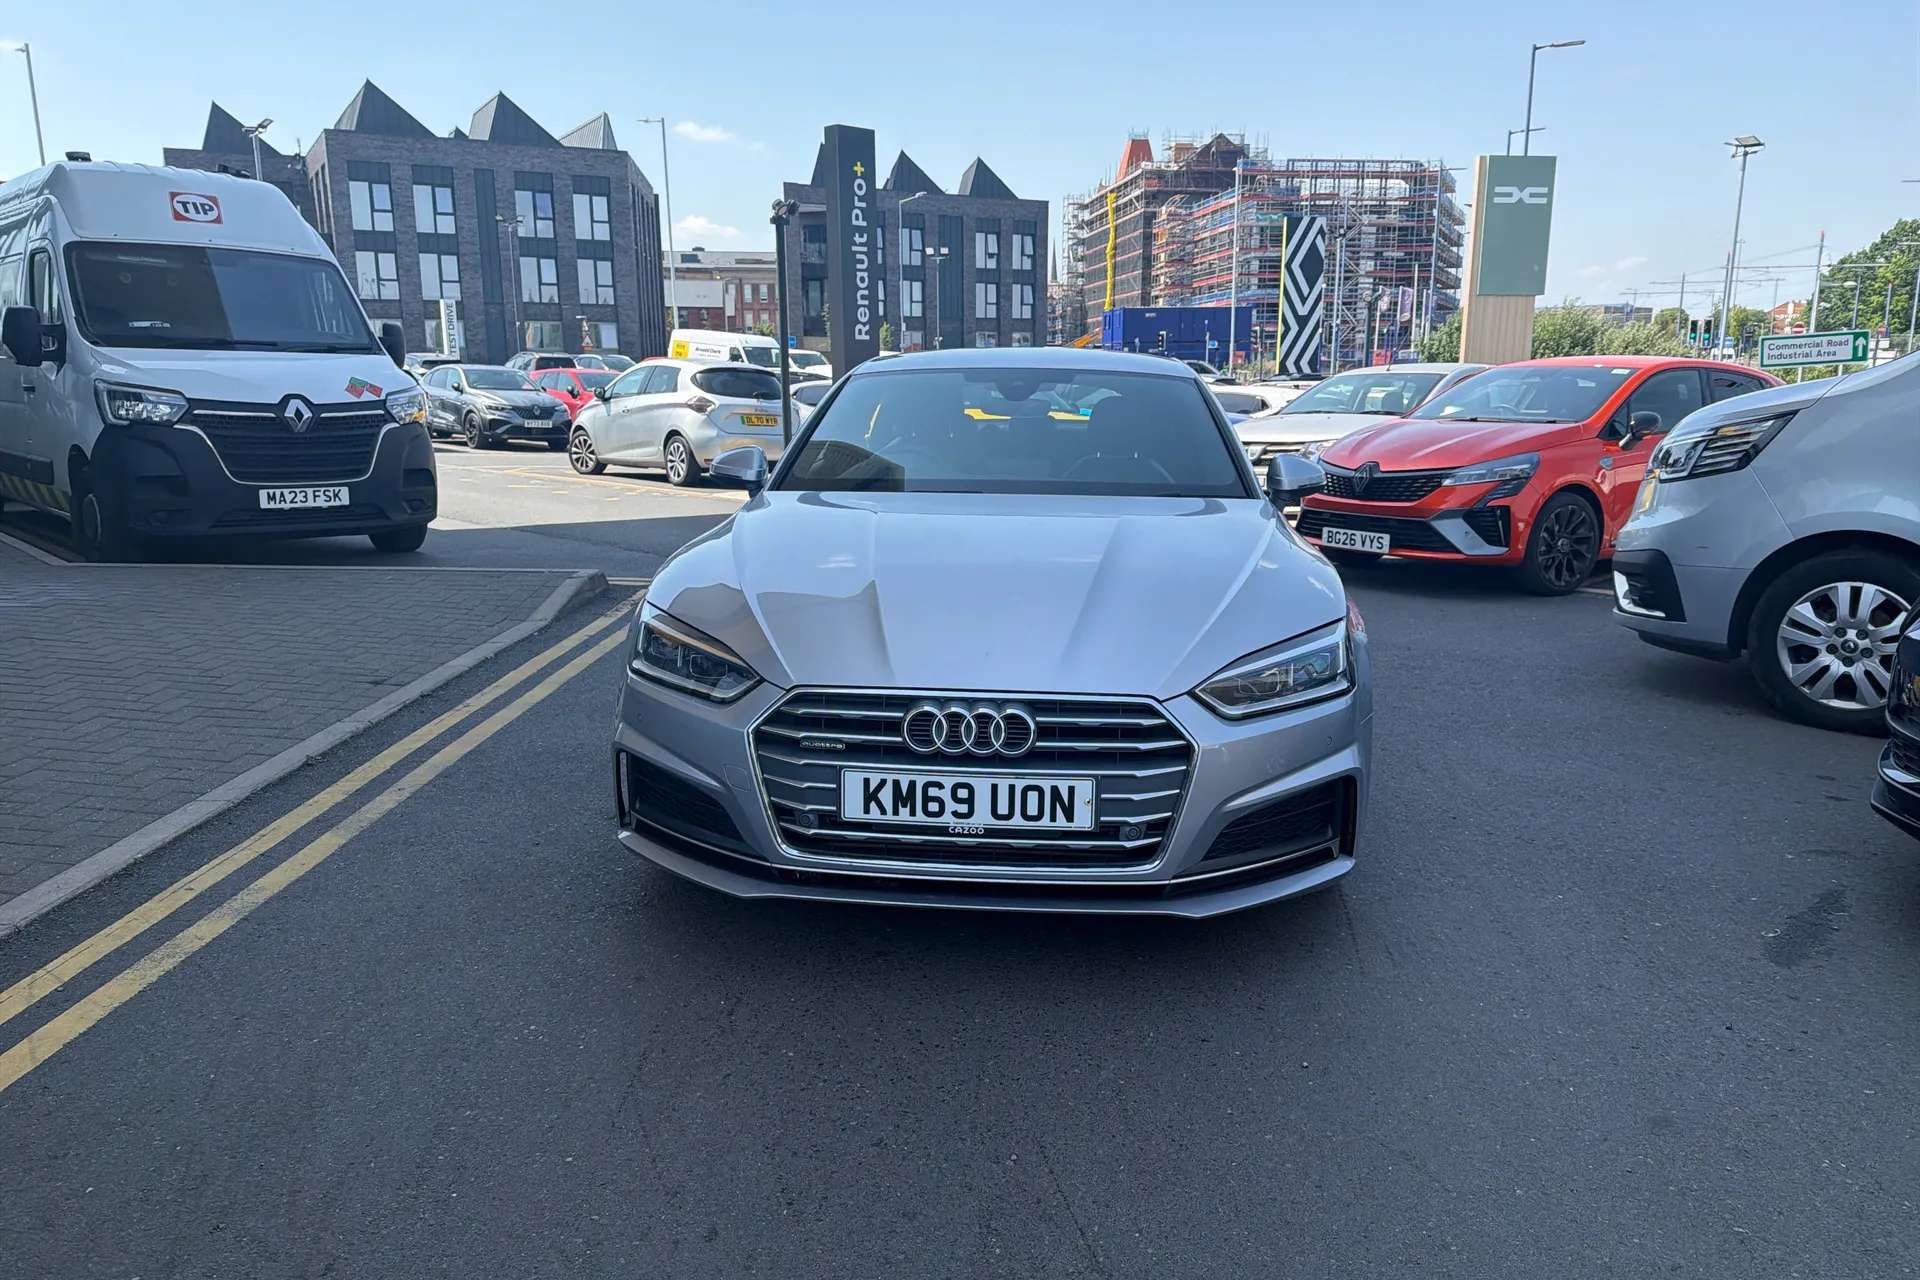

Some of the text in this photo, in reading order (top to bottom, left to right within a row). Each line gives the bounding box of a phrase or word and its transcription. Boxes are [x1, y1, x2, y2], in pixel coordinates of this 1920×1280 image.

[175, 200, 215, 216] TIP
[851, 232, 870, 341] Renault
[446, 302, 457, 353] TEST DRIVE
[1767, 338, 1849, 351] Commercial Road
[1767, 349, 1837, 361] Industrial Area
[266, 488, 342, 505] MA23 FSK
[1326, 530, 1384, 550] BG26 VYS
[862, 777, 1076, 823] KM69 UON
[948, 826, 985, 835] CAZOO
